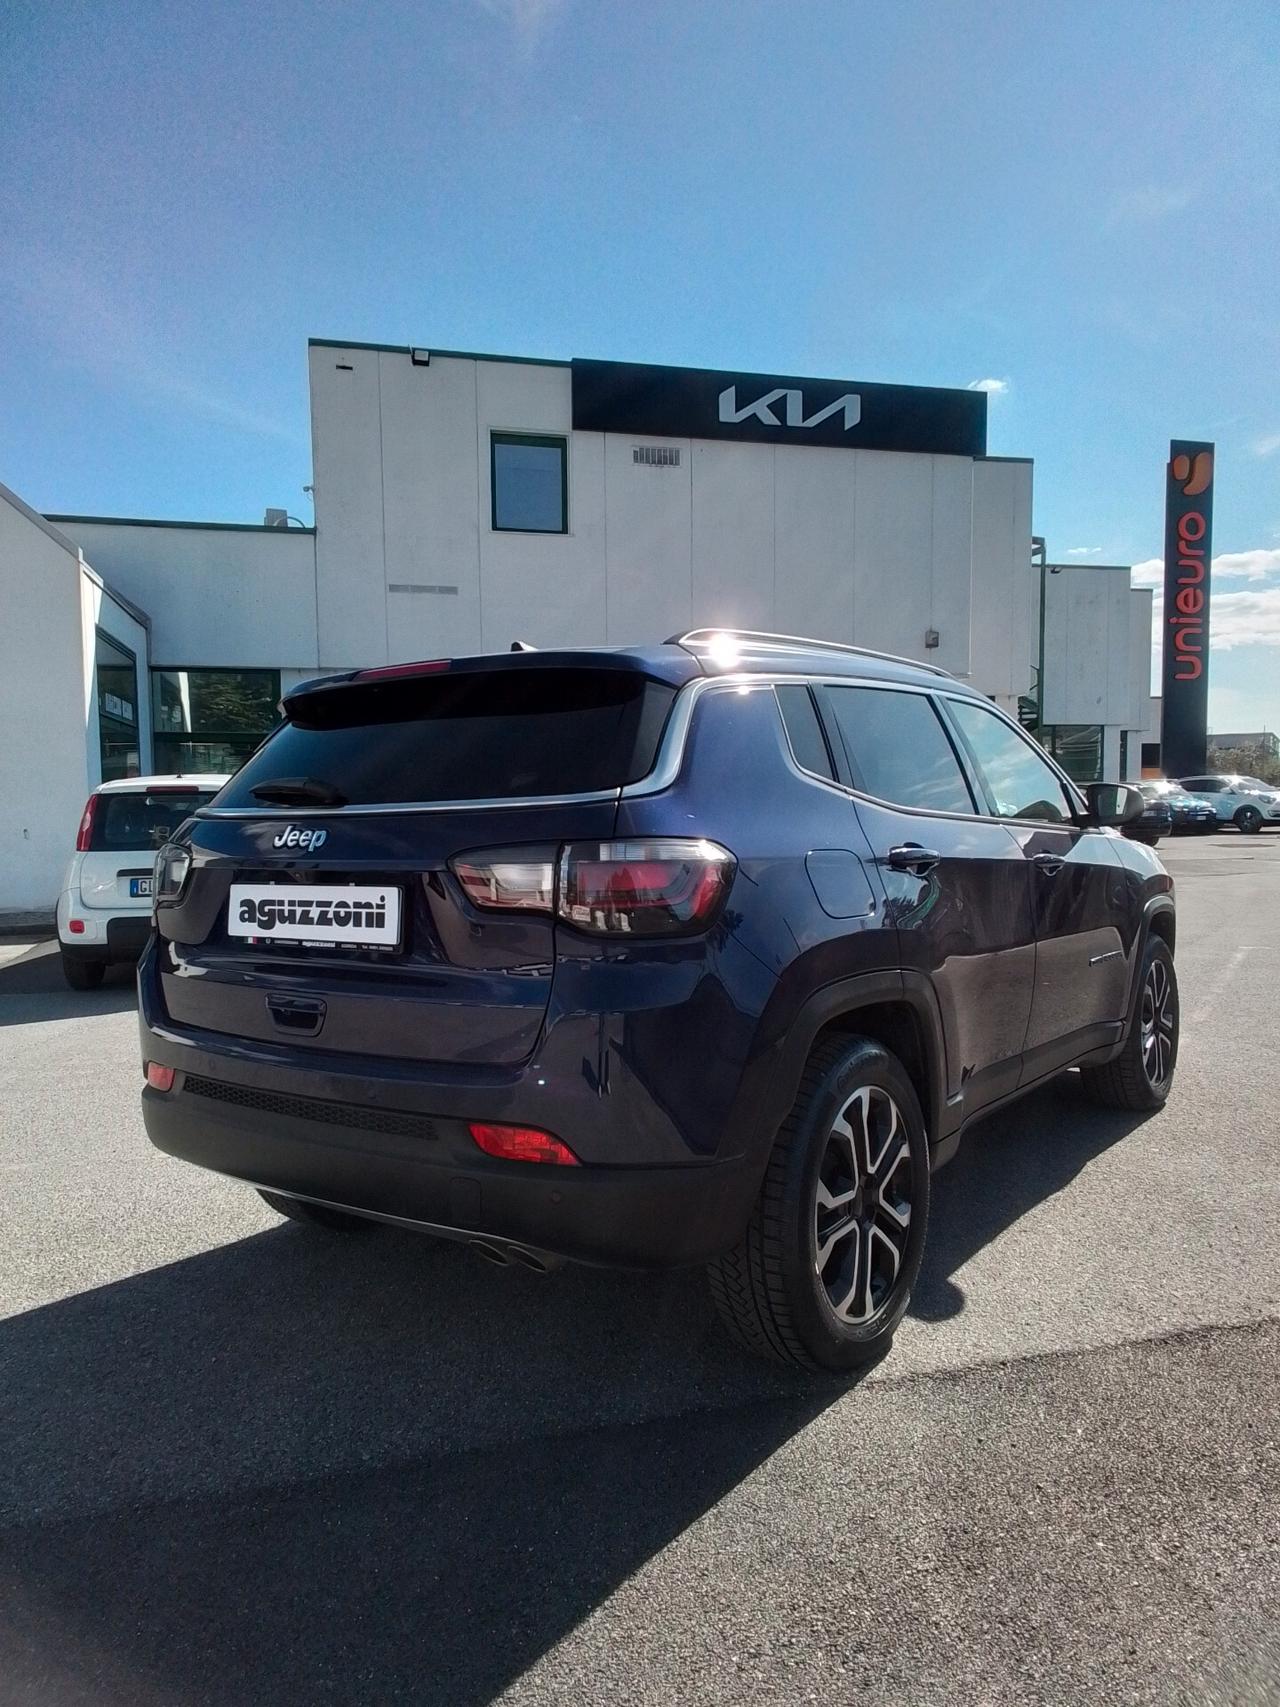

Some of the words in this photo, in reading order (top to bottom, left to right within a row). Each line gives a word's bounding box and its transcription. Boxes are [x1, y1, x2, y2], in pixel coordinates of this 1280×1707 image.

[719, 384, 861, 431] KIA
[1168, 512, 1206, 680] unieuro
[273, 825, 327, 852] Jeep
[239, 895, 386, 930] aguzzoni
